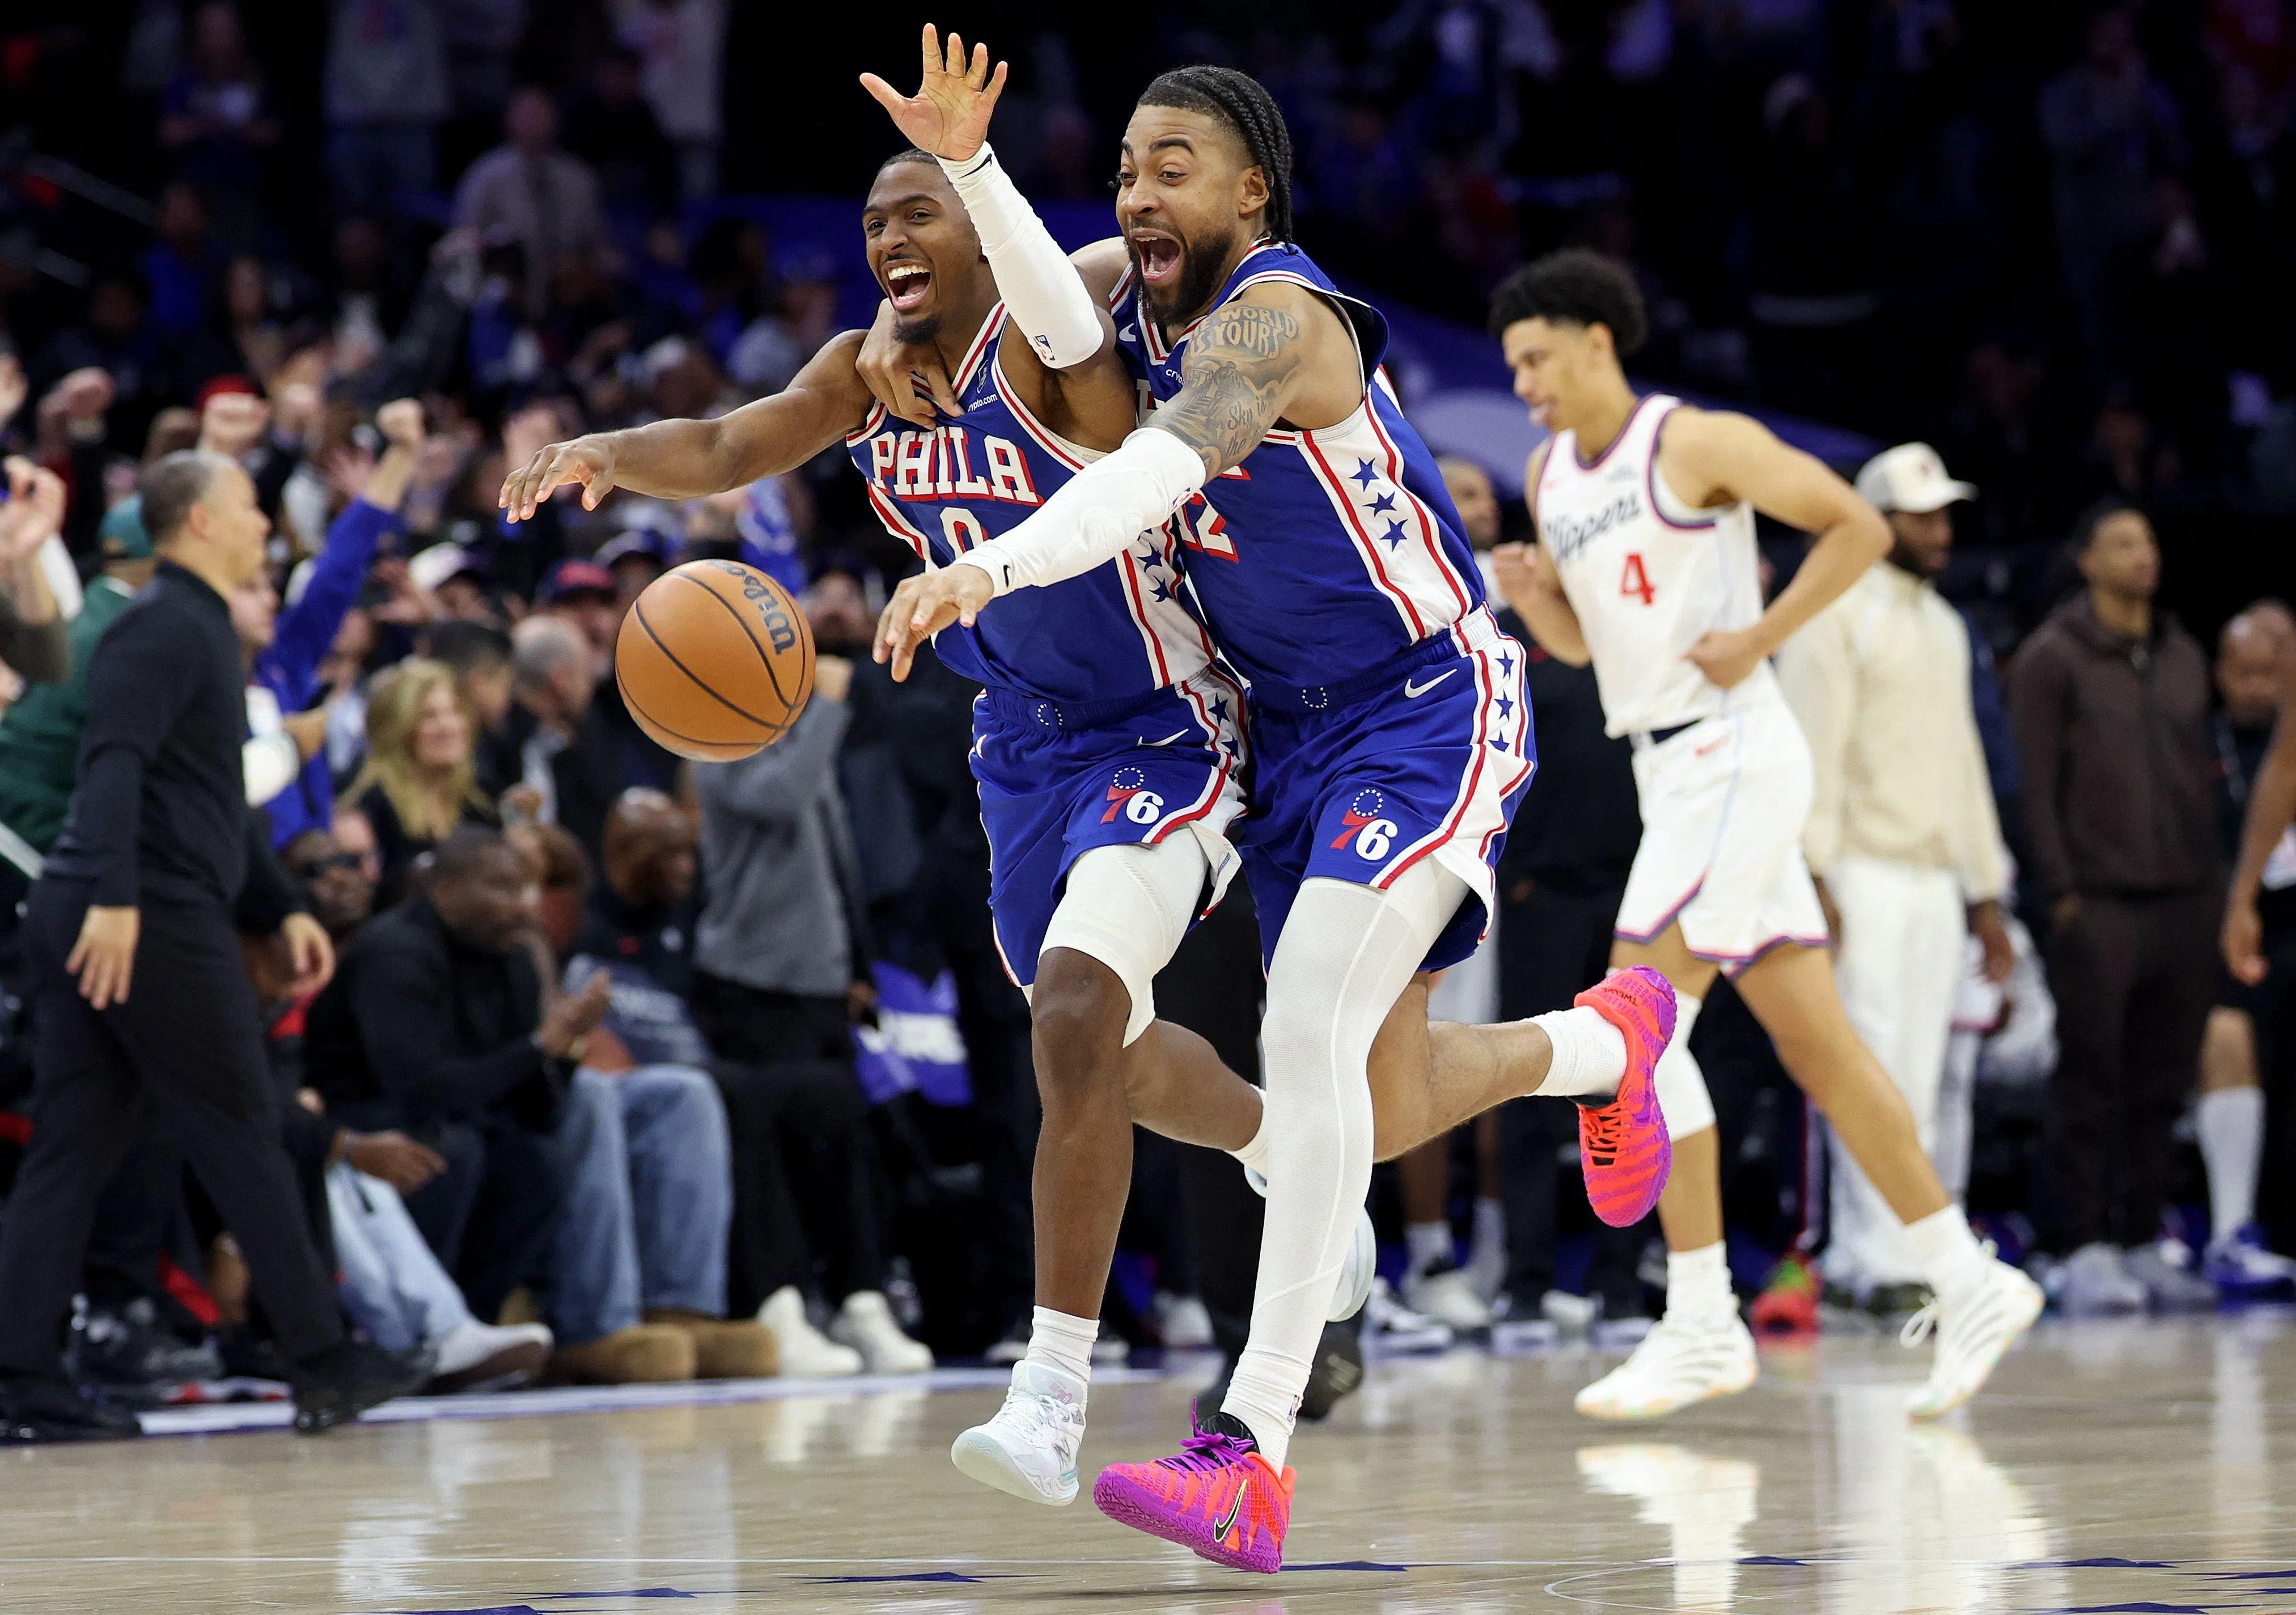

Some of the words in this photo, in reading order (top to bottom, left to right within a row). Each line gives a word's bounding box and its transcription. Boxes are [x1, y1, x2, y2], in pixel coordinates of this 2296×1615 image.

[868, 426, 1044, 507] PHILA
[1620, 551, 1656, 606] 4
[1099, 785, 1164, 826] 76
[1329, 808, 1399, 861] 76
[1602, 987, 1637, 1007] TWELVE
